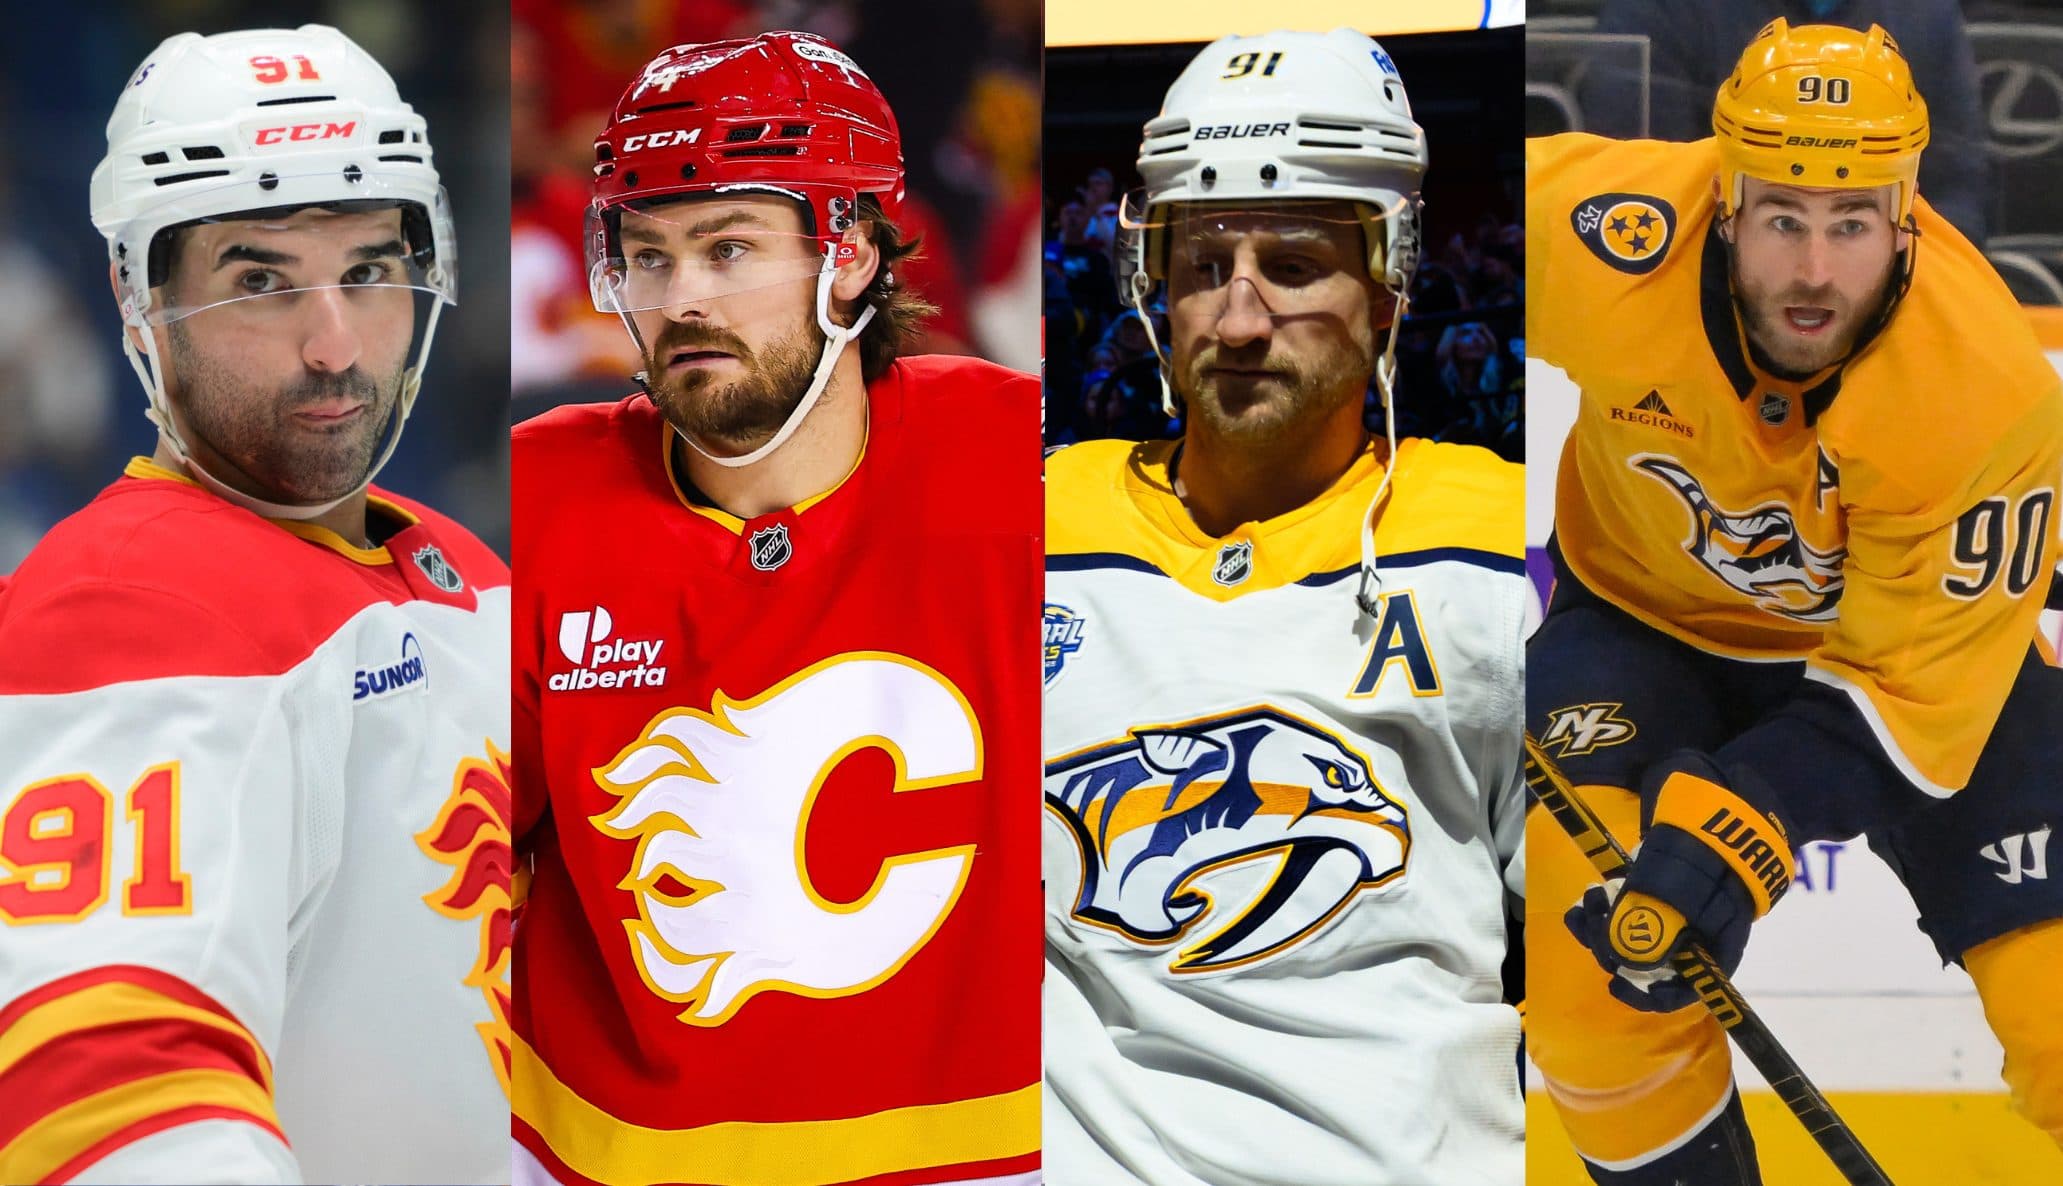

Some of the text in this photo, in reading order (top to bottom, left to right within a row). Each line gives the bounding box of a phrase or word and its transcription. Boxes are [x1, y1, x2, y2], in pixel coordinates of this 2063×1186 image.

[249, 54, 321, 84] 91
[1219, 51, 1284, 80] 91
[1797, 75, 1851, 106] 90
[255, 121, 356, 146] CCM
[623, 128, 702, 152] CCM
[1609, 407, 1695, 438] REGIONS
[761, 536, 782, 563] NHL
[1941, 487, 2054, 600] 90
[1220, 551, 1247, 578] NHL
[591, 638, 664, 668] play
[1347, 589, 1443, 698] A
[549, 666, 667, 691] alberta
[0, 761, 192, 926] 91
